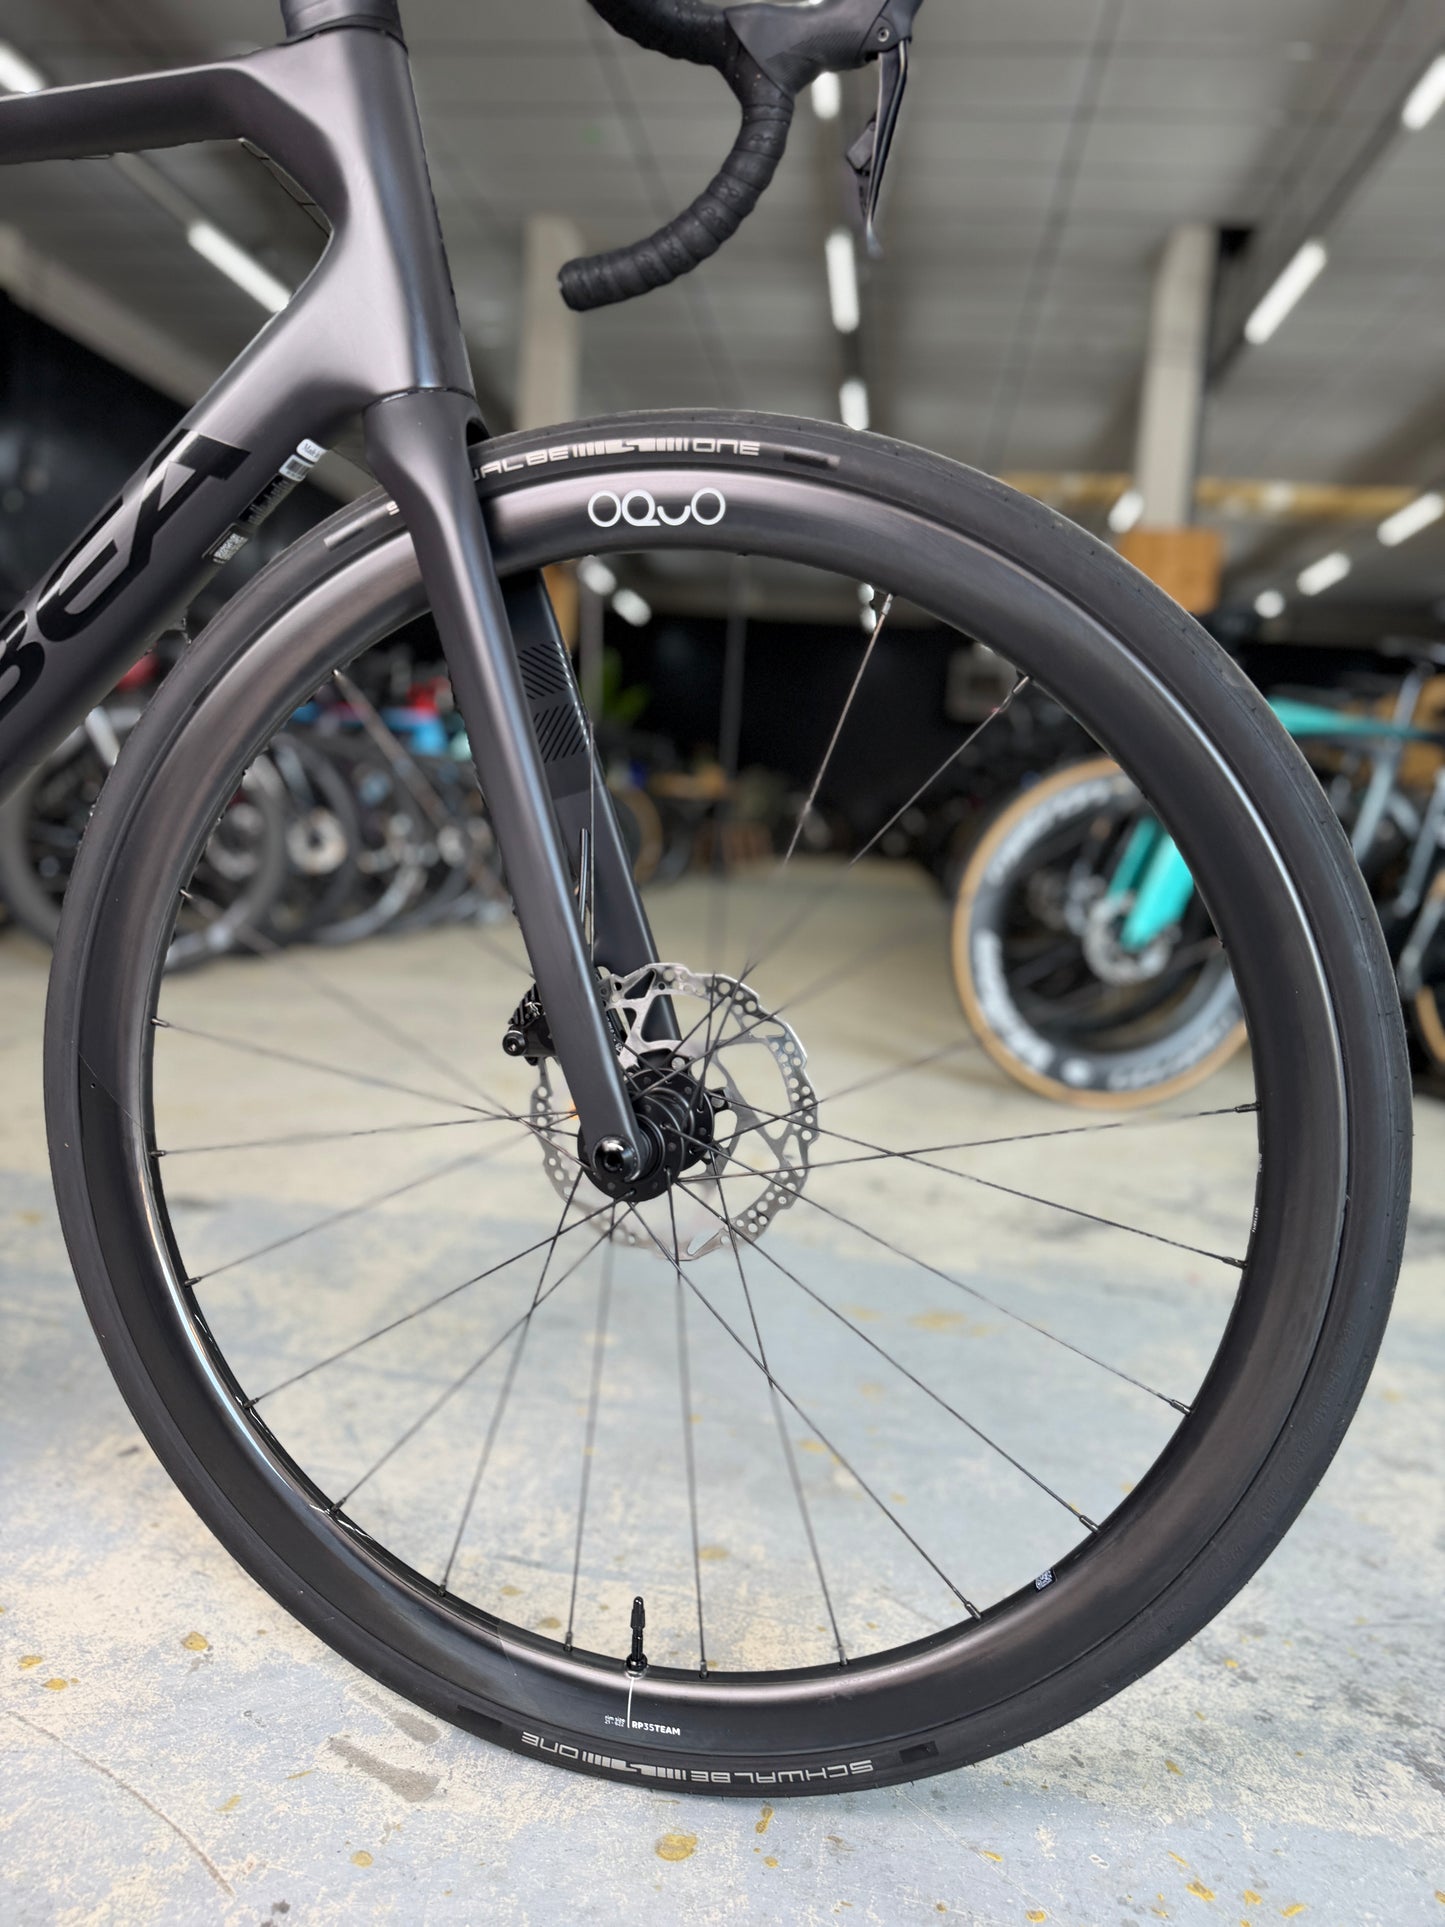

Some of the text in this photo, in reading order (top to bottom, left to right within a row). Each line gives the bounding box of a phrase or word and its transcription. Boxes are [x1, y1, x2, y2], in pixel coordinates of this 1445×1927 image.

[693, 438, 760, 456] ONE
[631, 1720, 681, 1736] RP35TEAM
[521, 1731, 873, 1784] SCHWALBE ONE
